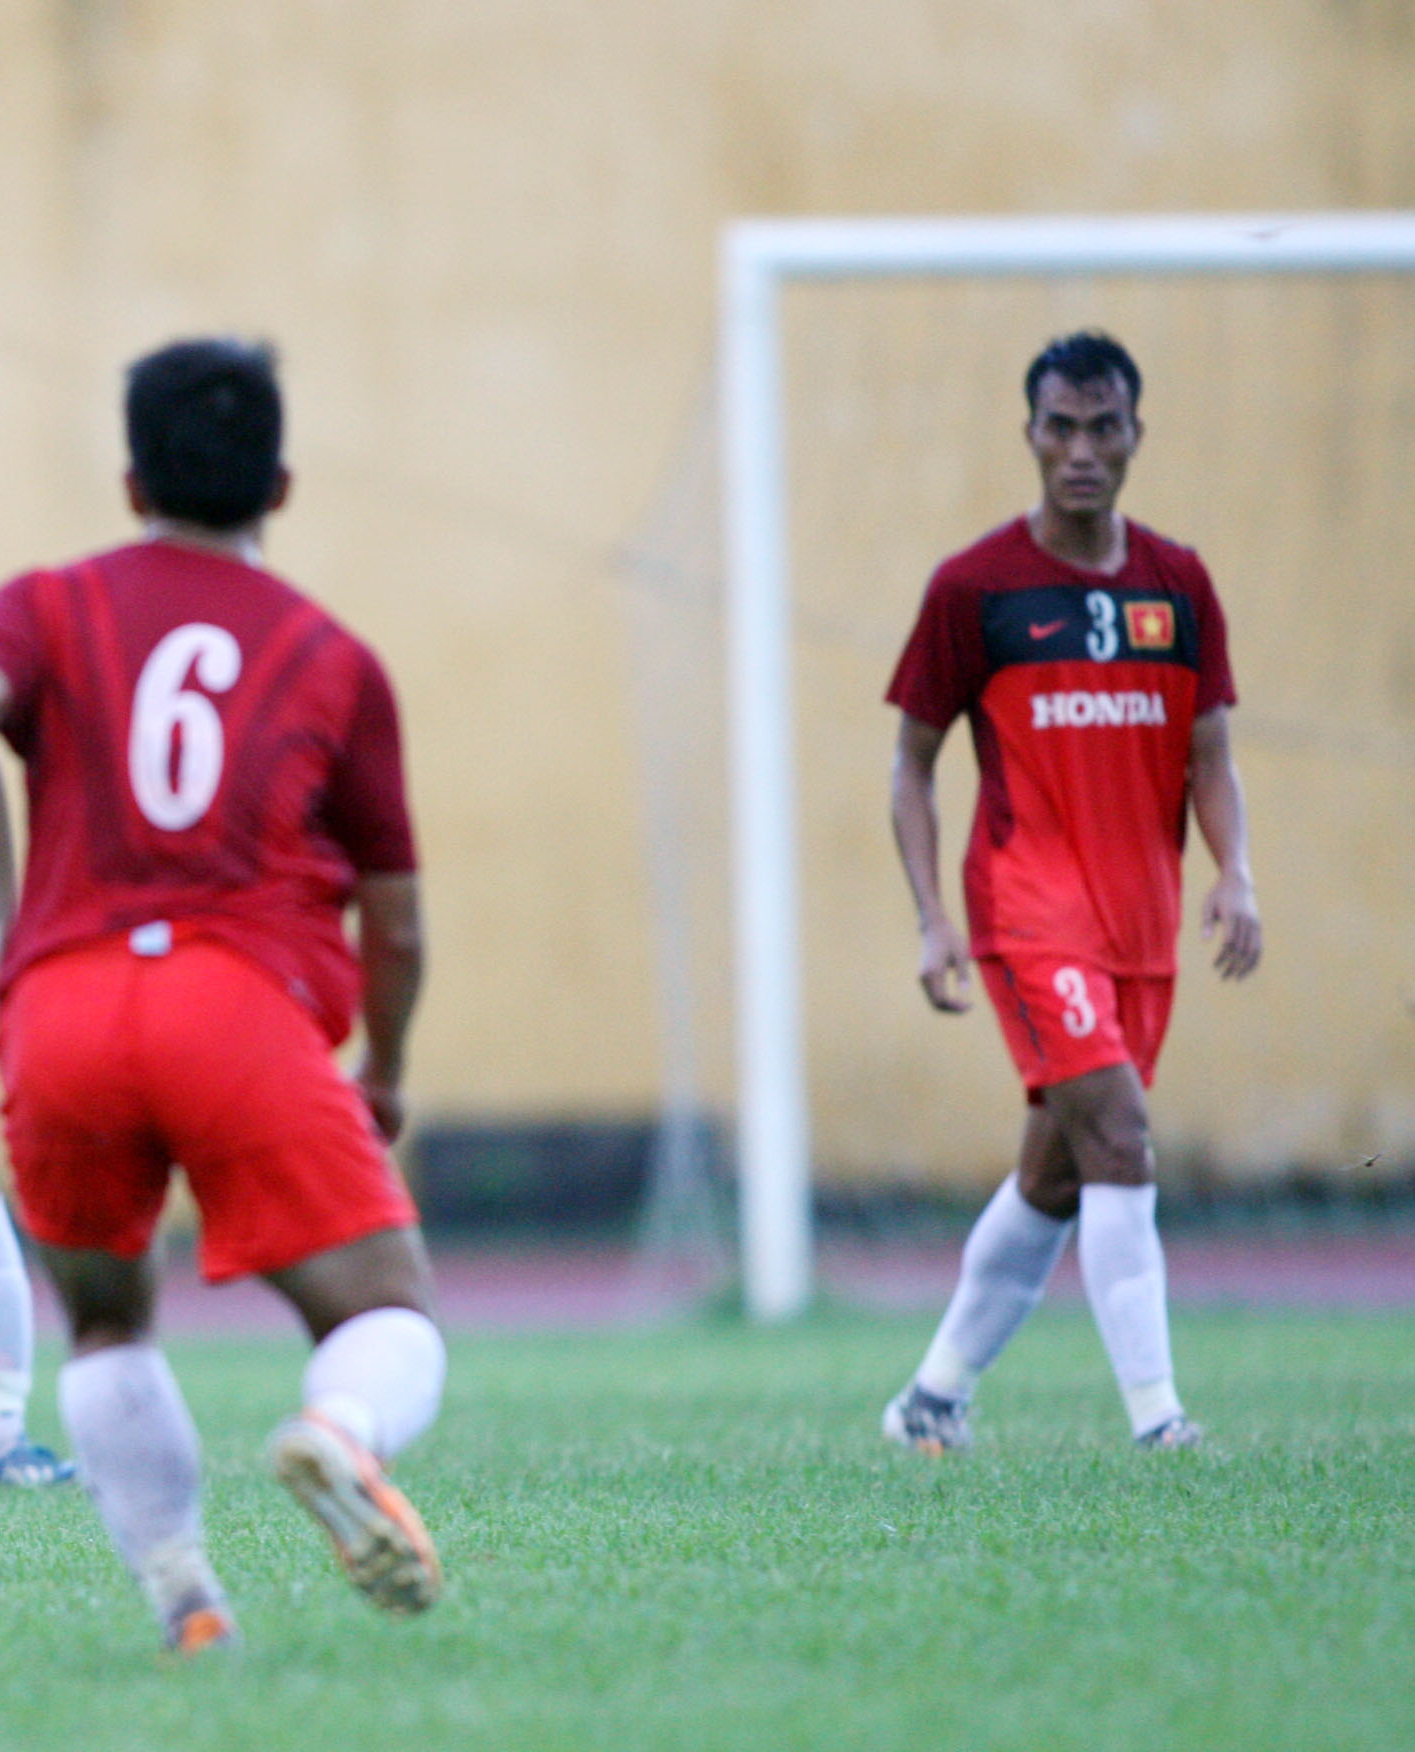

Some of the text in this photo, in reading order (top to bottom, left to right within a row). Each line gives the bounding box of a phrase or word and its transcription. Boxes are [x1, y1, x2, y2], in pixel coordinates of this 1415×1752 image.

[1086, 589, 1119, 663] 3
[128, 622, 243, 832] 6
[1032, 690, 1167, 729] HONDA
[1052, 966, 1097, 1038] 3
